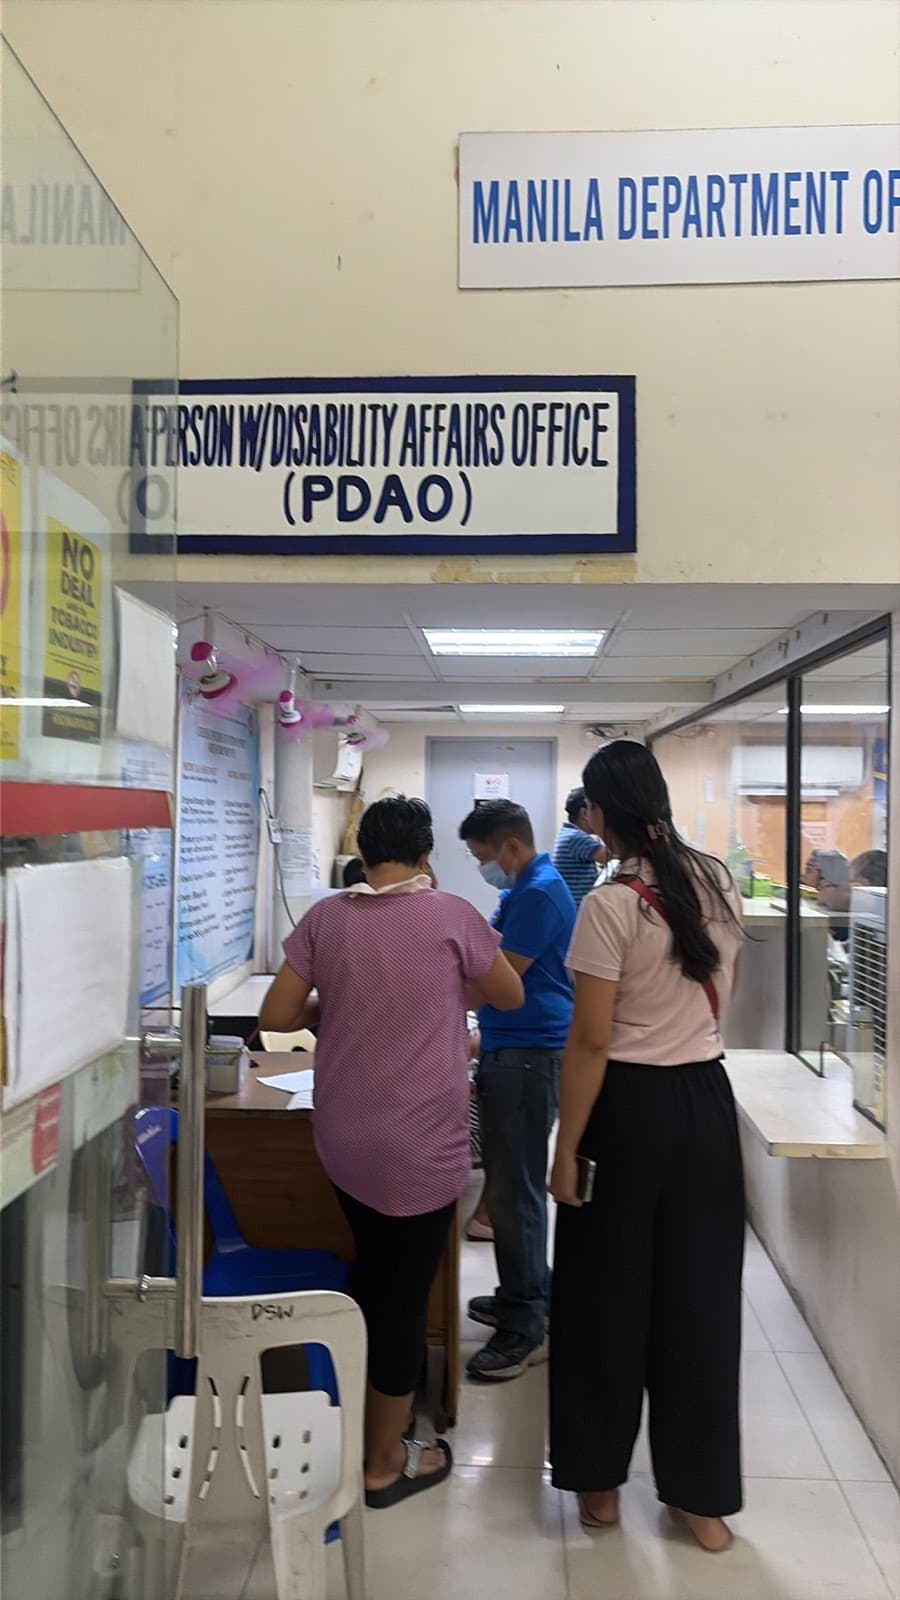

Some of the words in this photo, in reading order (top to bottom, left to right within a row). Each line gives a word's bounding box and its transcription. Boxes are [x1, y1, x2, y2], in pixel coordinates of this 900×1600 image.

[472, 178, 604, 244] MANILA
[618, 170, 850, 241] DEPARTMENT
[862, 168, 900, 236] OF
[150, 403, 234, 468] PERSON
[239, 402, 398, 472] W/DISABILITY
[400, 402, 506, 468] AFFAIRS
[512, 401, 611, 468] OFFICE
[282, 470, 474, 527] (PDAO)
[61, 531, 95, 581] NO
[61, 570, 95, 609] DEAL
[251, 1303, 295, 1321] DSW
